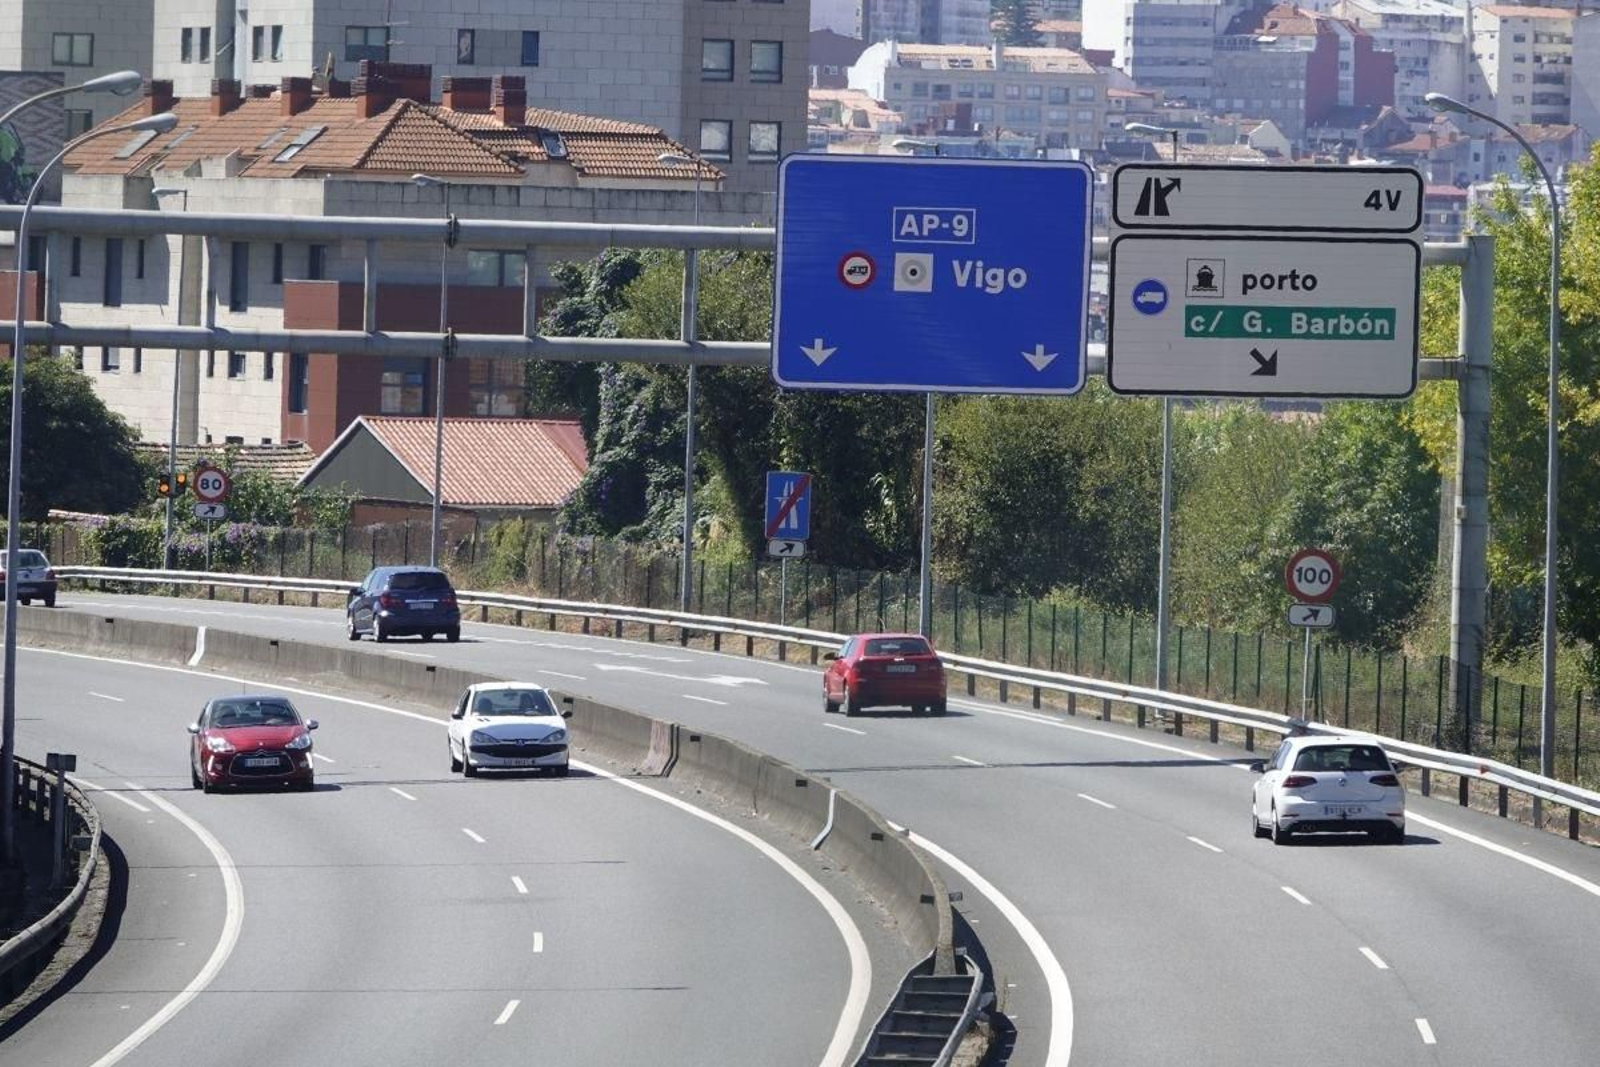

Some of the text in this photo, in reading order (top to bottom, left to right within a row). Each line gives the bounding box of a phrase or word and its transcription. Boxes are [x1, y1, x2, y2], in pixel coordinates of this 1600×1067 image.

[1364, 190, 1401, 211] 4V
[900, 214, 968, 236] AP-9
[952, 260, 1027, 293] Vigo
[1242, 269, 1317, 295] porto
[1190, 311, 1390, 335] c/ G. Barbón
[201, 478, 222, 490] 80
[1296, 566, 1331, 585] 100
